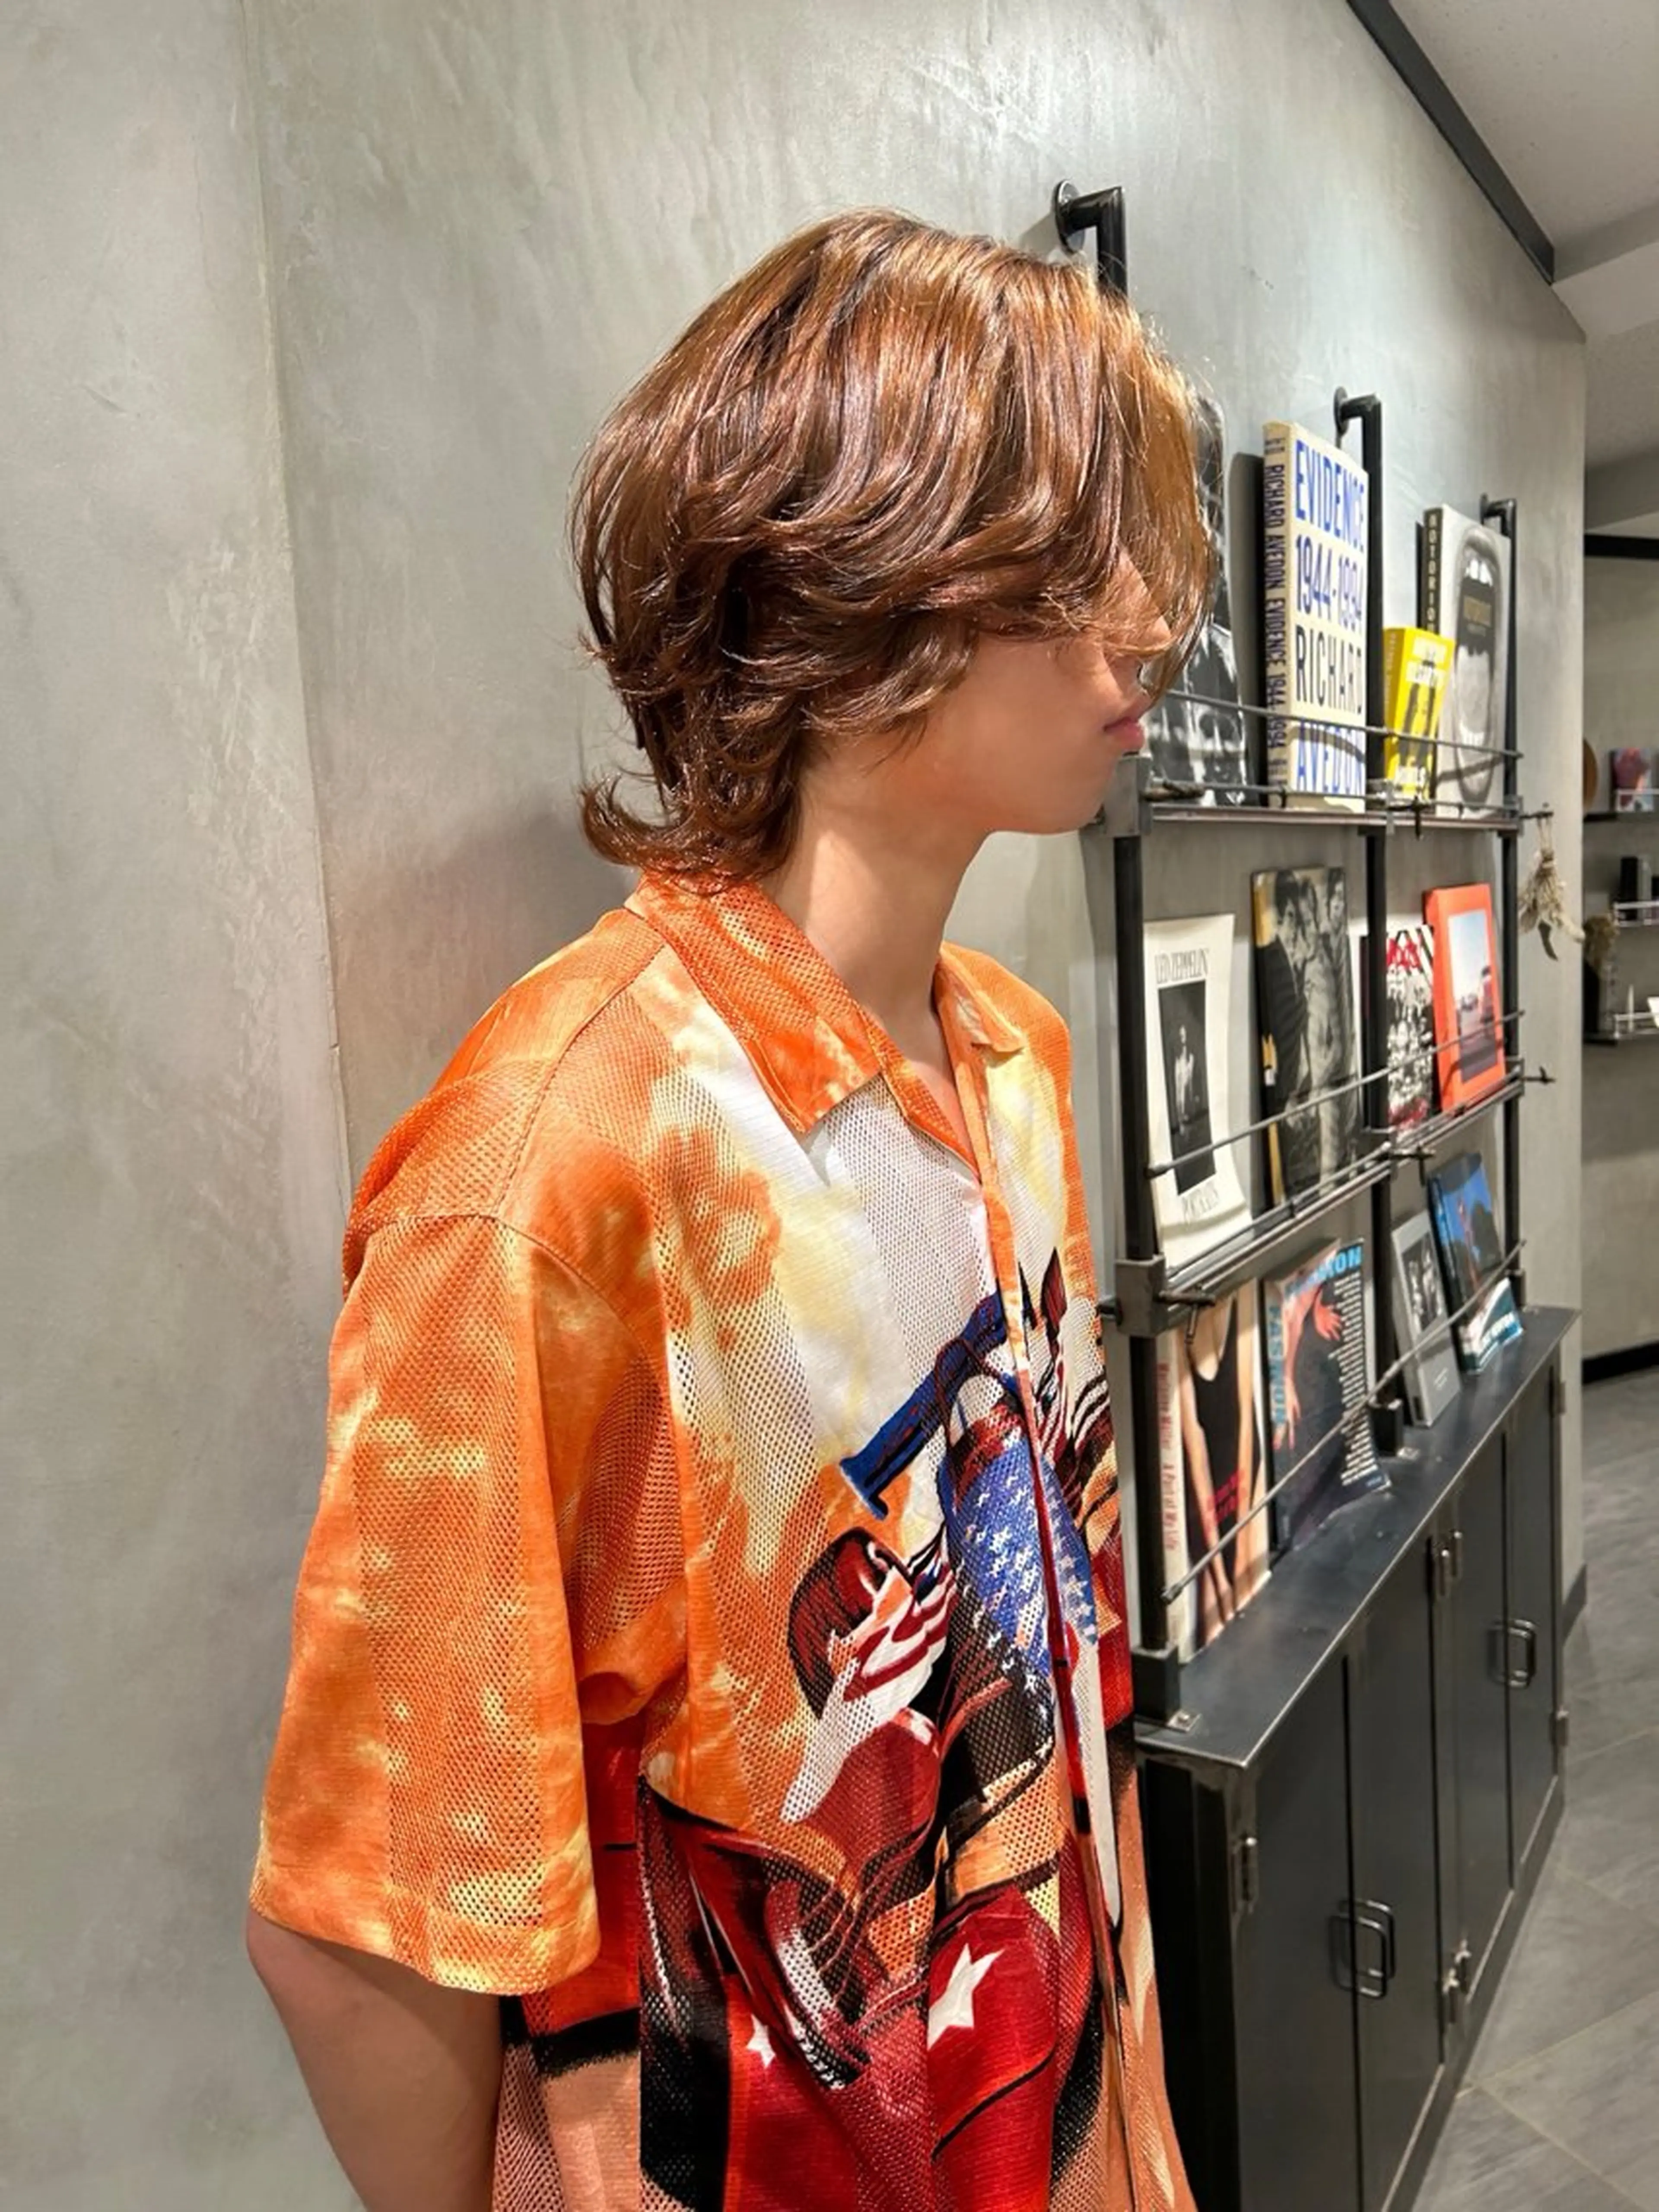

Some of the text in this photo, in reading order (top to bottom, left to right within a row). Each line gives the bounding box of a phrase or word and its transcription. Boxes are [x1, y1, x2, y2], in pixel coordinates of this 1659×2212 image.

[1264, 464, 1285, 528] RICHARD
[1296, 439, 1365, 553] EVIDENCE
[1265, 535, 1285, 590] AVEDON
[1266, 598, 1286, 666] EVIDENCE
[1296, 624, 1362, 715] RICHARD
[1297, 715, 1365, 797] AVEDON
